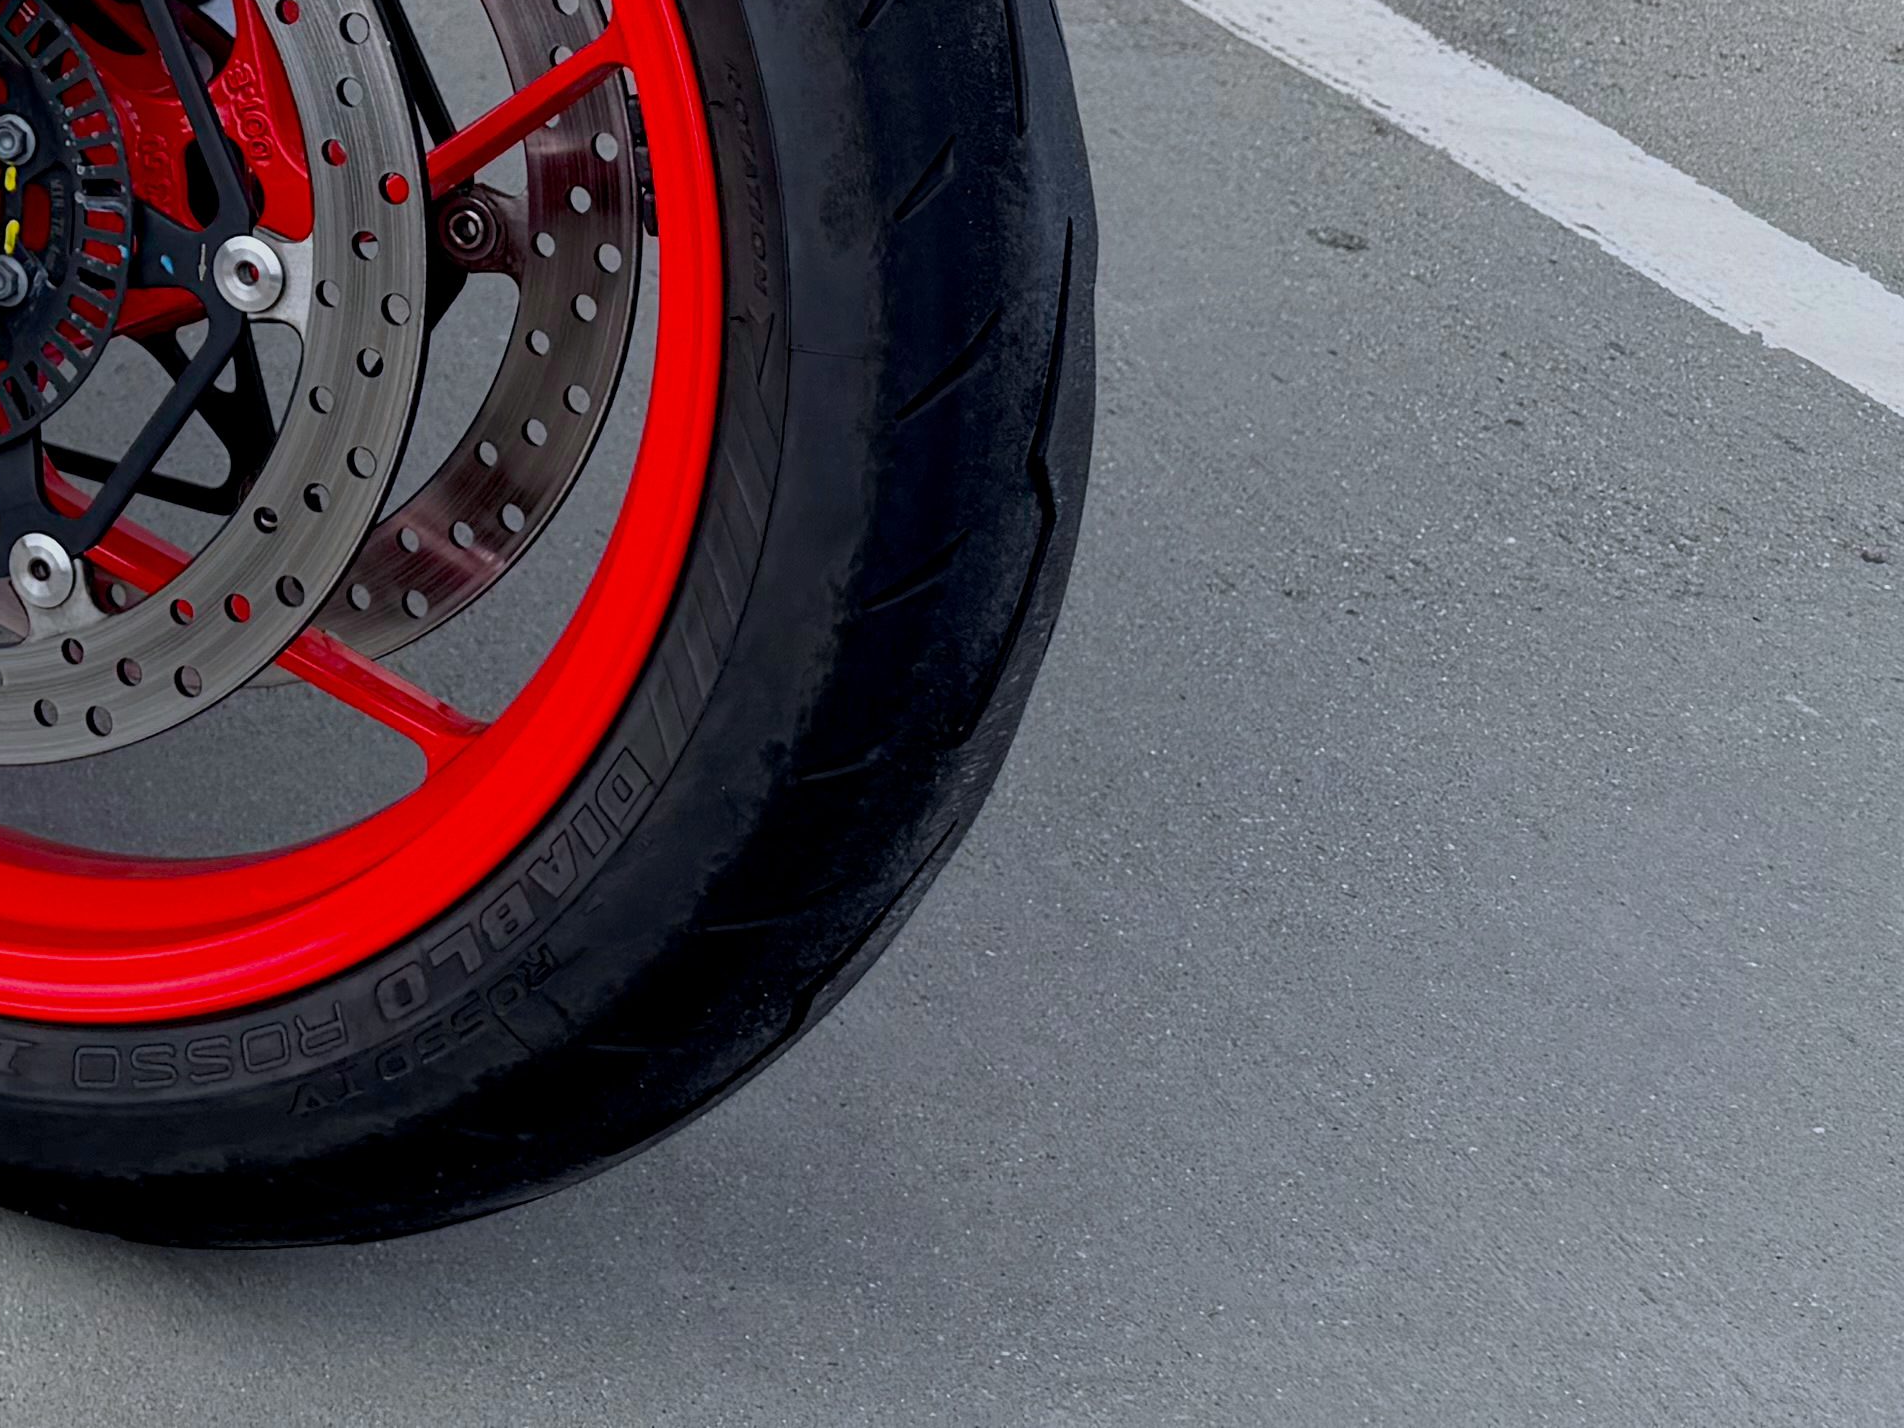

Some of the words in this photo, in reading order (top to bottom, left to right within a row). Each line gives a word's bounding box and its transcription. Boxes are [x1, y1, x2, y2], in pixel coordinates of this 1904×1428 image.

[374, 747, 654, 1022] DIABLO
[72, 999, 351, 1090] ROSSO
[375, 941, 561, 1082] ROSSO
